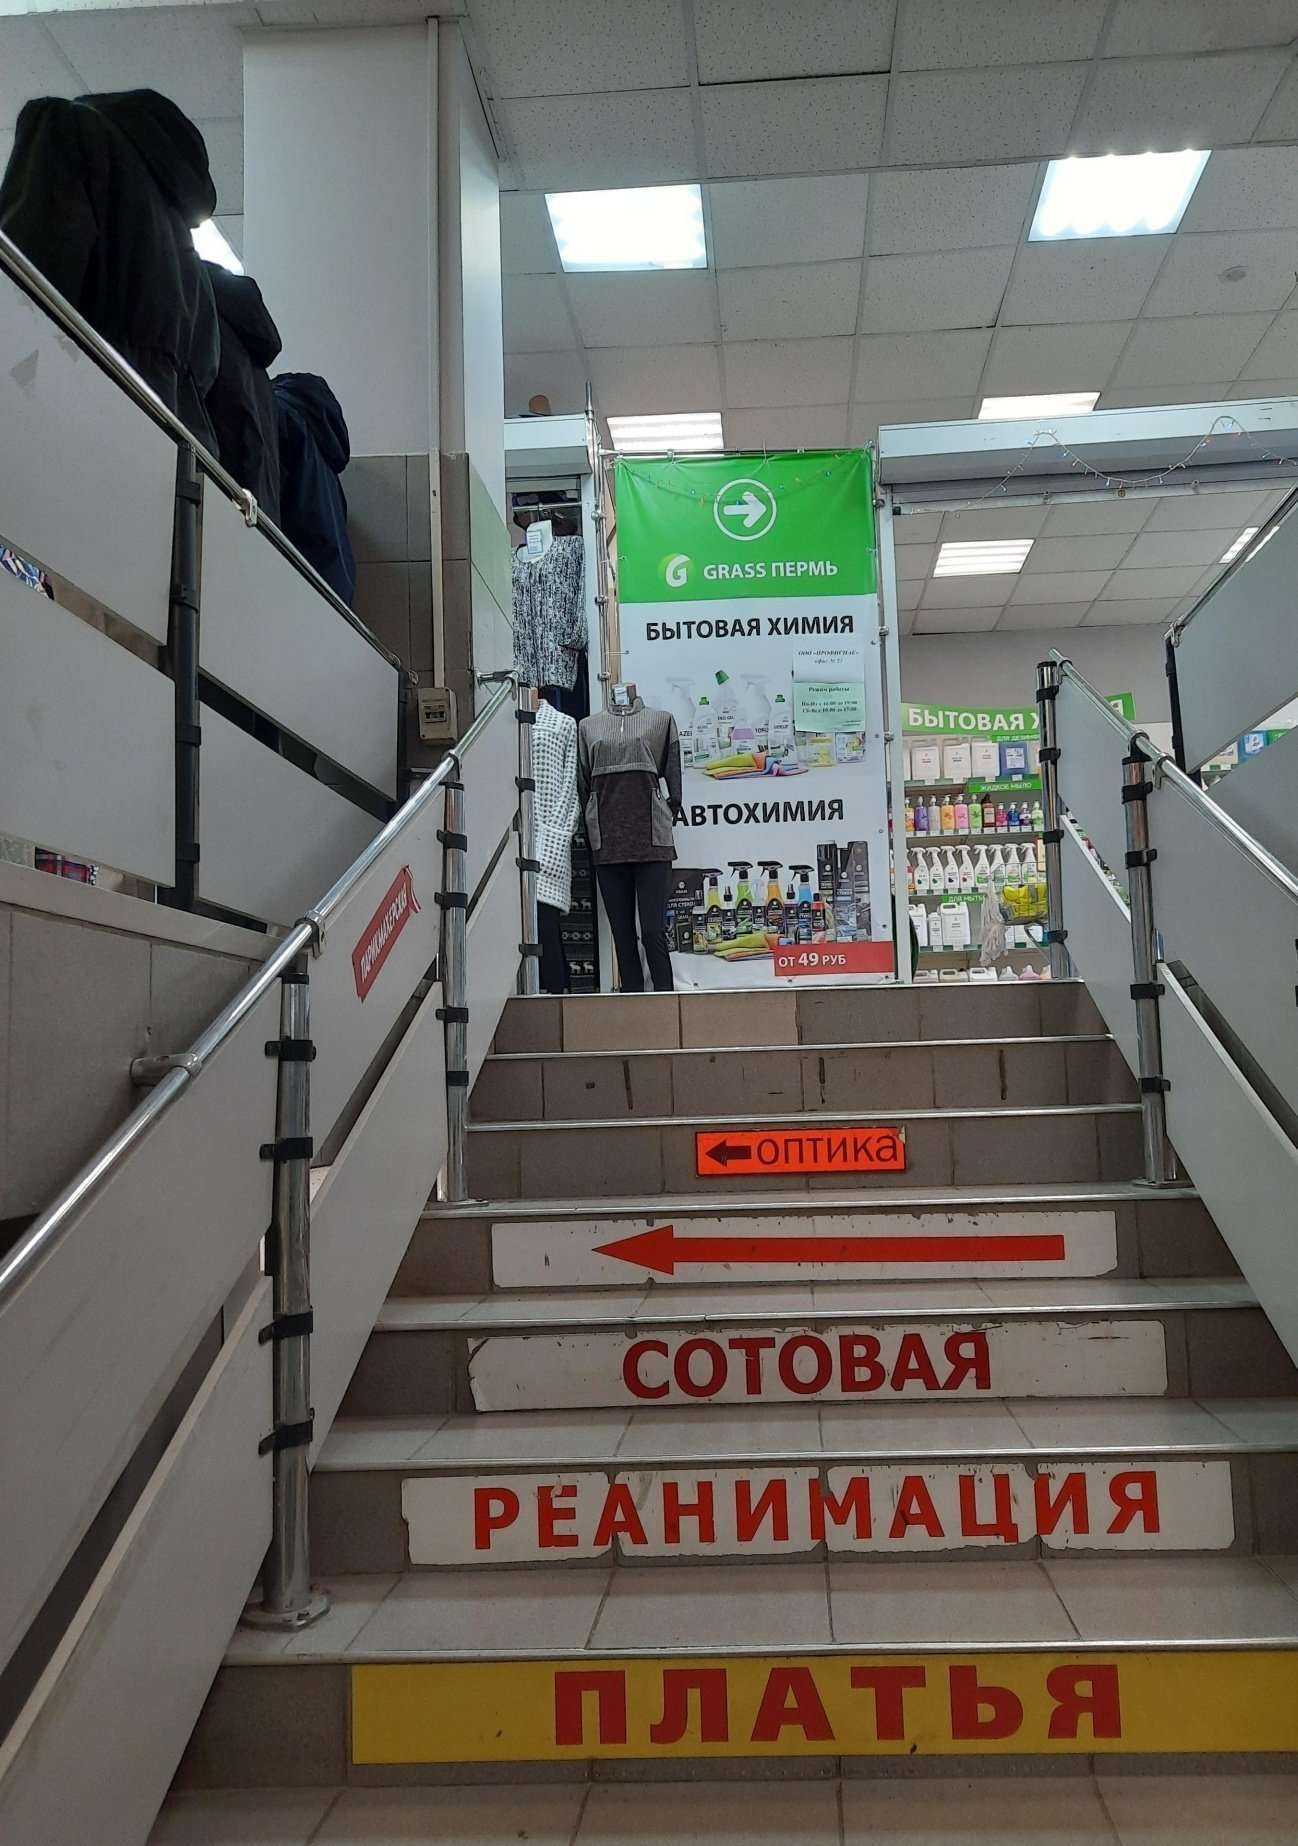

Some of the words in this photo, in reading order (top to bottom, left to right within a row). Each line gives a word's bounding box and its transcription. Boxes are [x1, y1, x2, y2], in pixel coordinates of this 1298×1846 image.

[703, 562, 767, 580] GRASS
[771, 560, 838, 577] ПЕРМЬ
[646, 618, 761, 641] БЫТОВАЯ
[767, 615, 854, 636] ХИМИЯ
[908, 708, 1025, 731] БЫТОВАЯ
[672, 799, 844, 827] АВТОХИМИЯ
[778, 956, 795, 968] ОТ
[798, 952, 819, 966] 49
[822, 954, 846, 965] РУБ
[622, 1332, 991, 1398] СОТОВАЯ
[474, 1470, 1160, 1549] РЕАНИМАЦИЯ
[555, 1664, 1121, 1746] ПЛАТЬЯ
